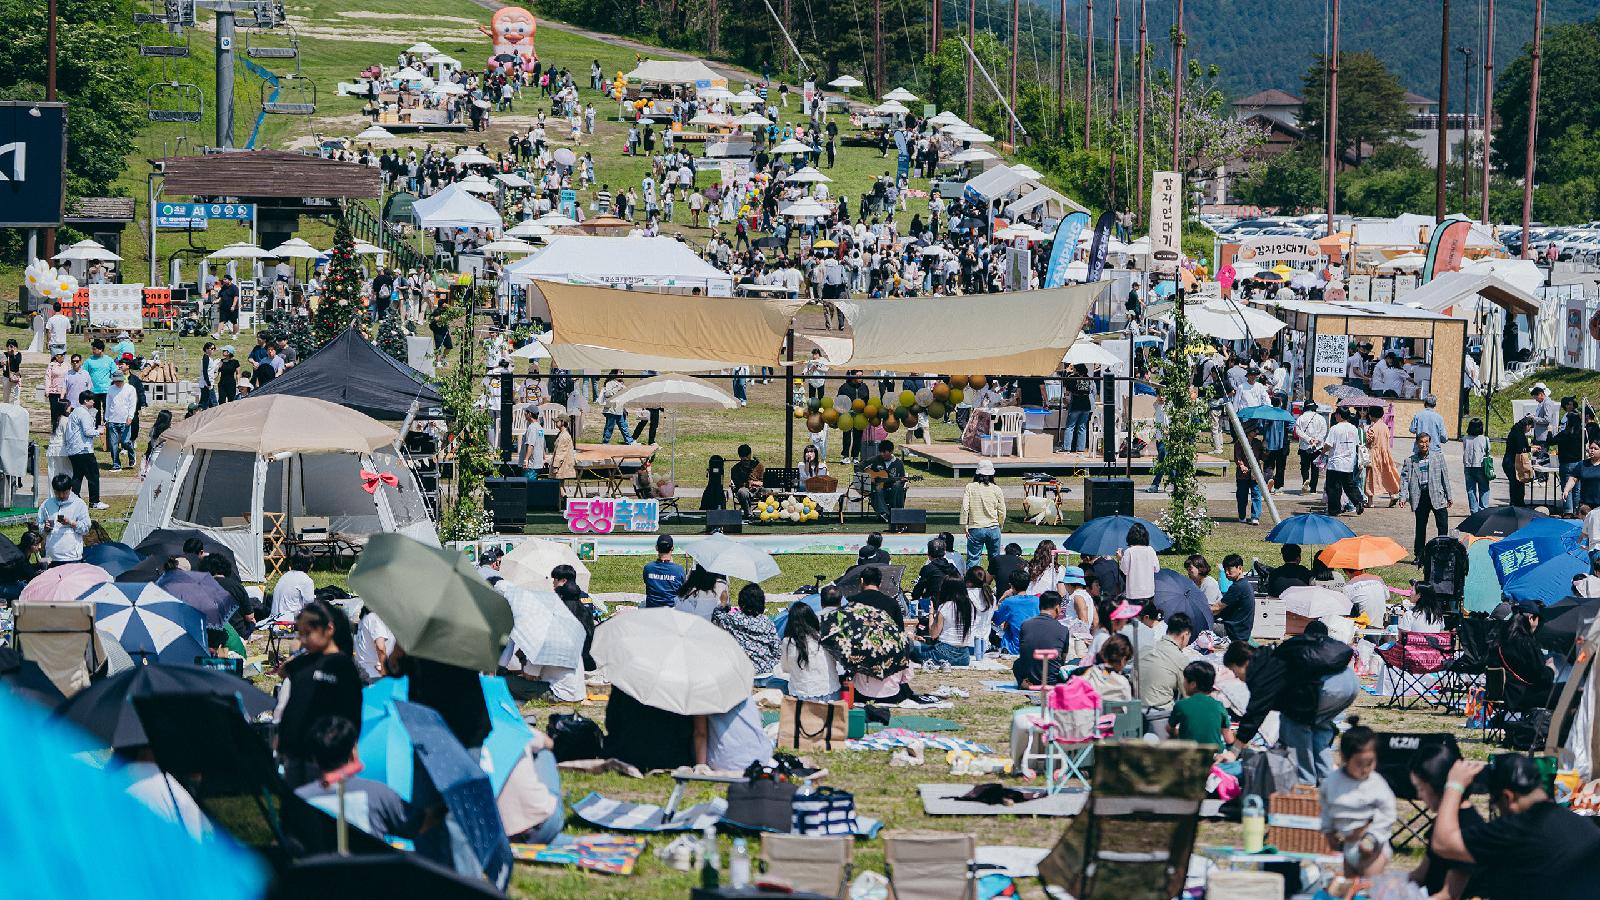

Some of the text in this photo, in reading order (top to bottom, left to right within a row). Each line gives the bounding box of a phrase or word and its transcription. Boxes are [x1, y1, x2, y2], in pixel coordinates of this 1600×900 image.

[1162, 177, 1174, 248] 감자연대기
[1052, 221, 1082, 287] AMPING
[1255, 243, 1308, 256] 감자연대기
[1315, 366, 1344, 374] COFFEE
[567, 499, 657, 533] 동행축제
